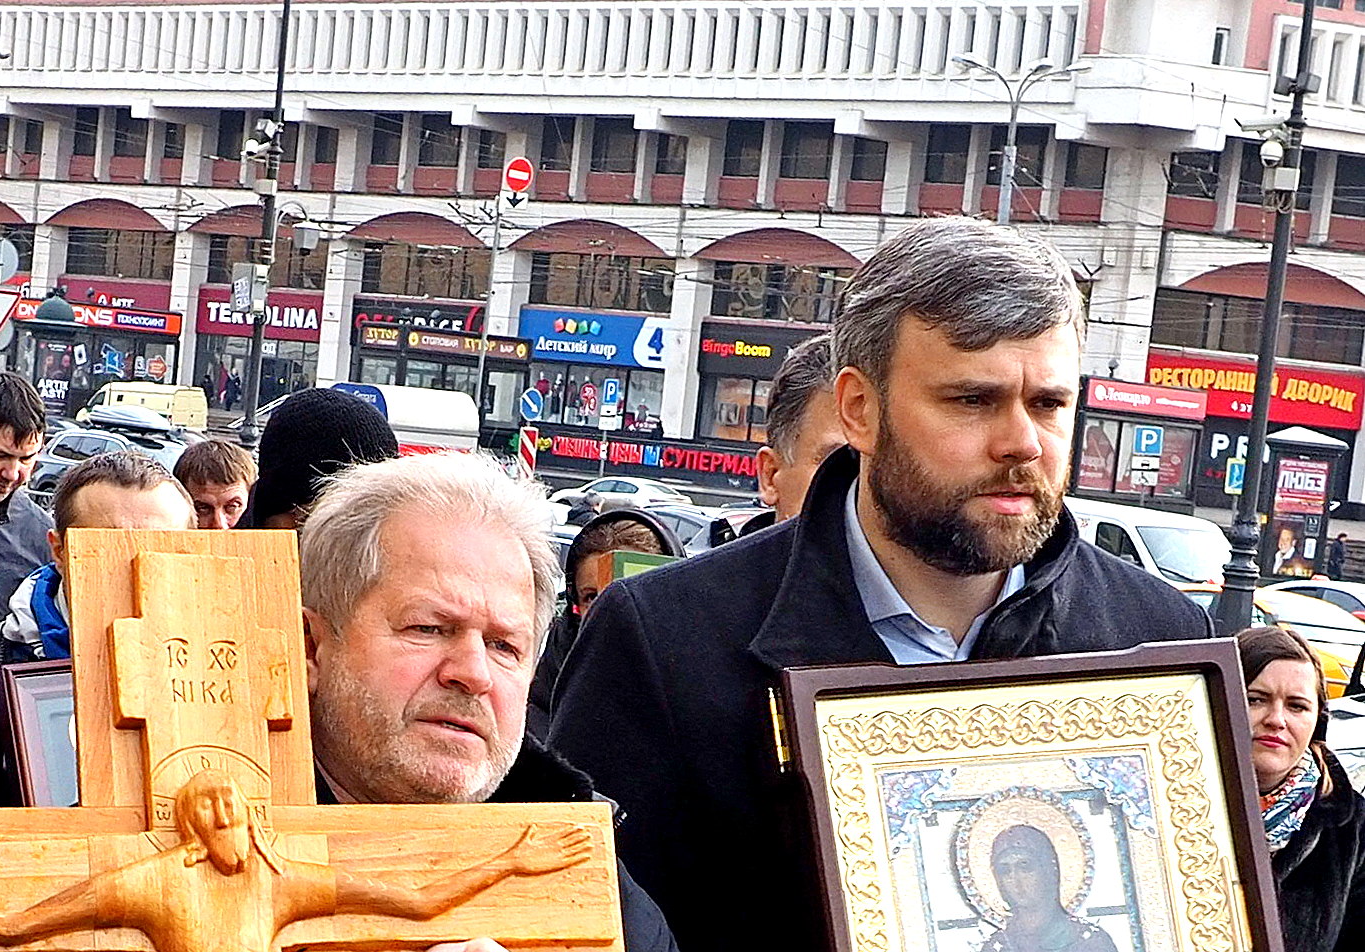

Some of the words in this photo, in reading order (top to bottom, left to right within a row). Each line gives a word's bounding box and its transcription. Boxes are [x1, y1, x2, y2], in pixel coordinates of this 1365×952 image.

[18, 303, 38, 316] DN
[535, 336, 588, 354] Детский
[588, 343, 617, 360] мир
[647, 327, 664, 354] 4
[1281, 378, 1356, 412] ДВОРИК
[1141, 433, 1158, 453] P
[663, 447, 758, 476] СУПЕРМА
